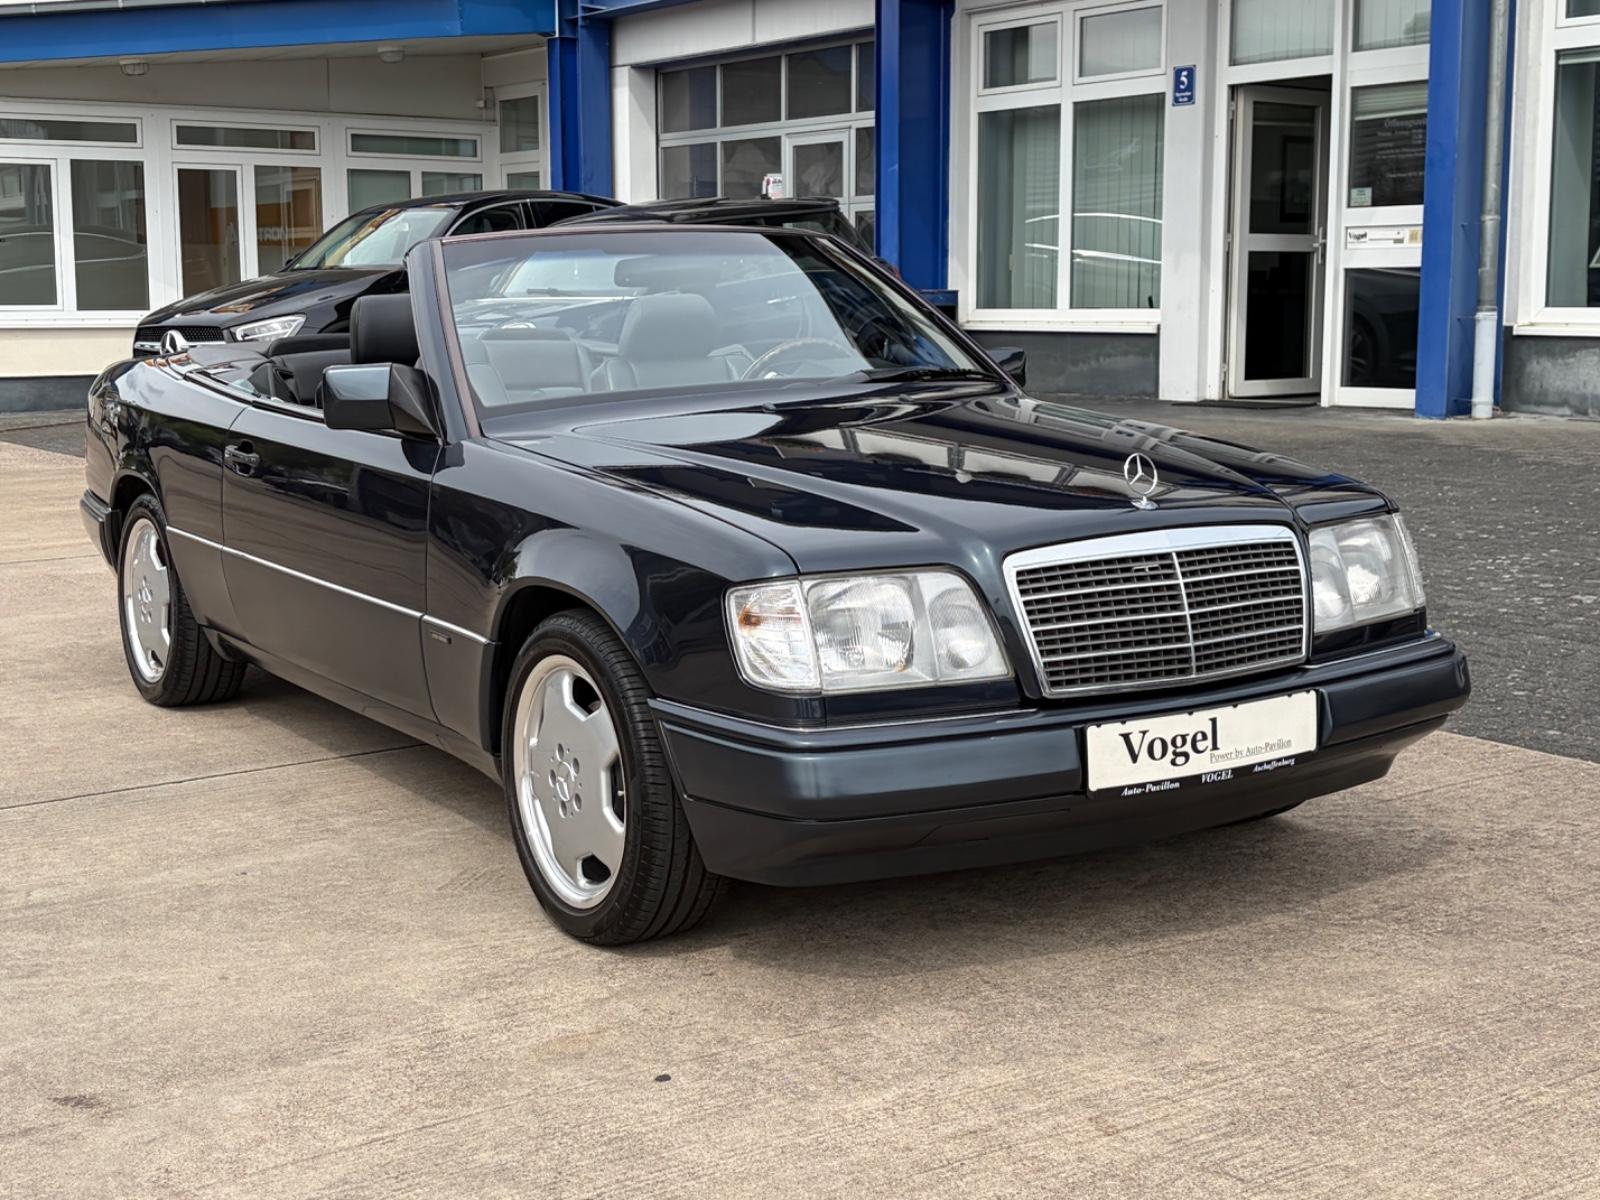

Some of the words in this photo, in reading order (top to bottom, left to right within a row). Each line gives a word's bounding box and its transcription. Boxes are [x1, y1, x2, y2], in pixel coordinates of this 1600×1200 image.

[1179, 71, 1188, 89] 5
[1119, 717, 1220, 767] Vogel
[1210, 750, 1233, 764] Power
[1235, 746, 1244, 758] by
[1246, 738, 1292, 757] Auto-Pavillon
[1121, 781, 1180, 797] Auto-Pavillon
[1201, 769, 1234, 784] VOGEL
[1252, 757, 1296, 773] Aschaffenburg
